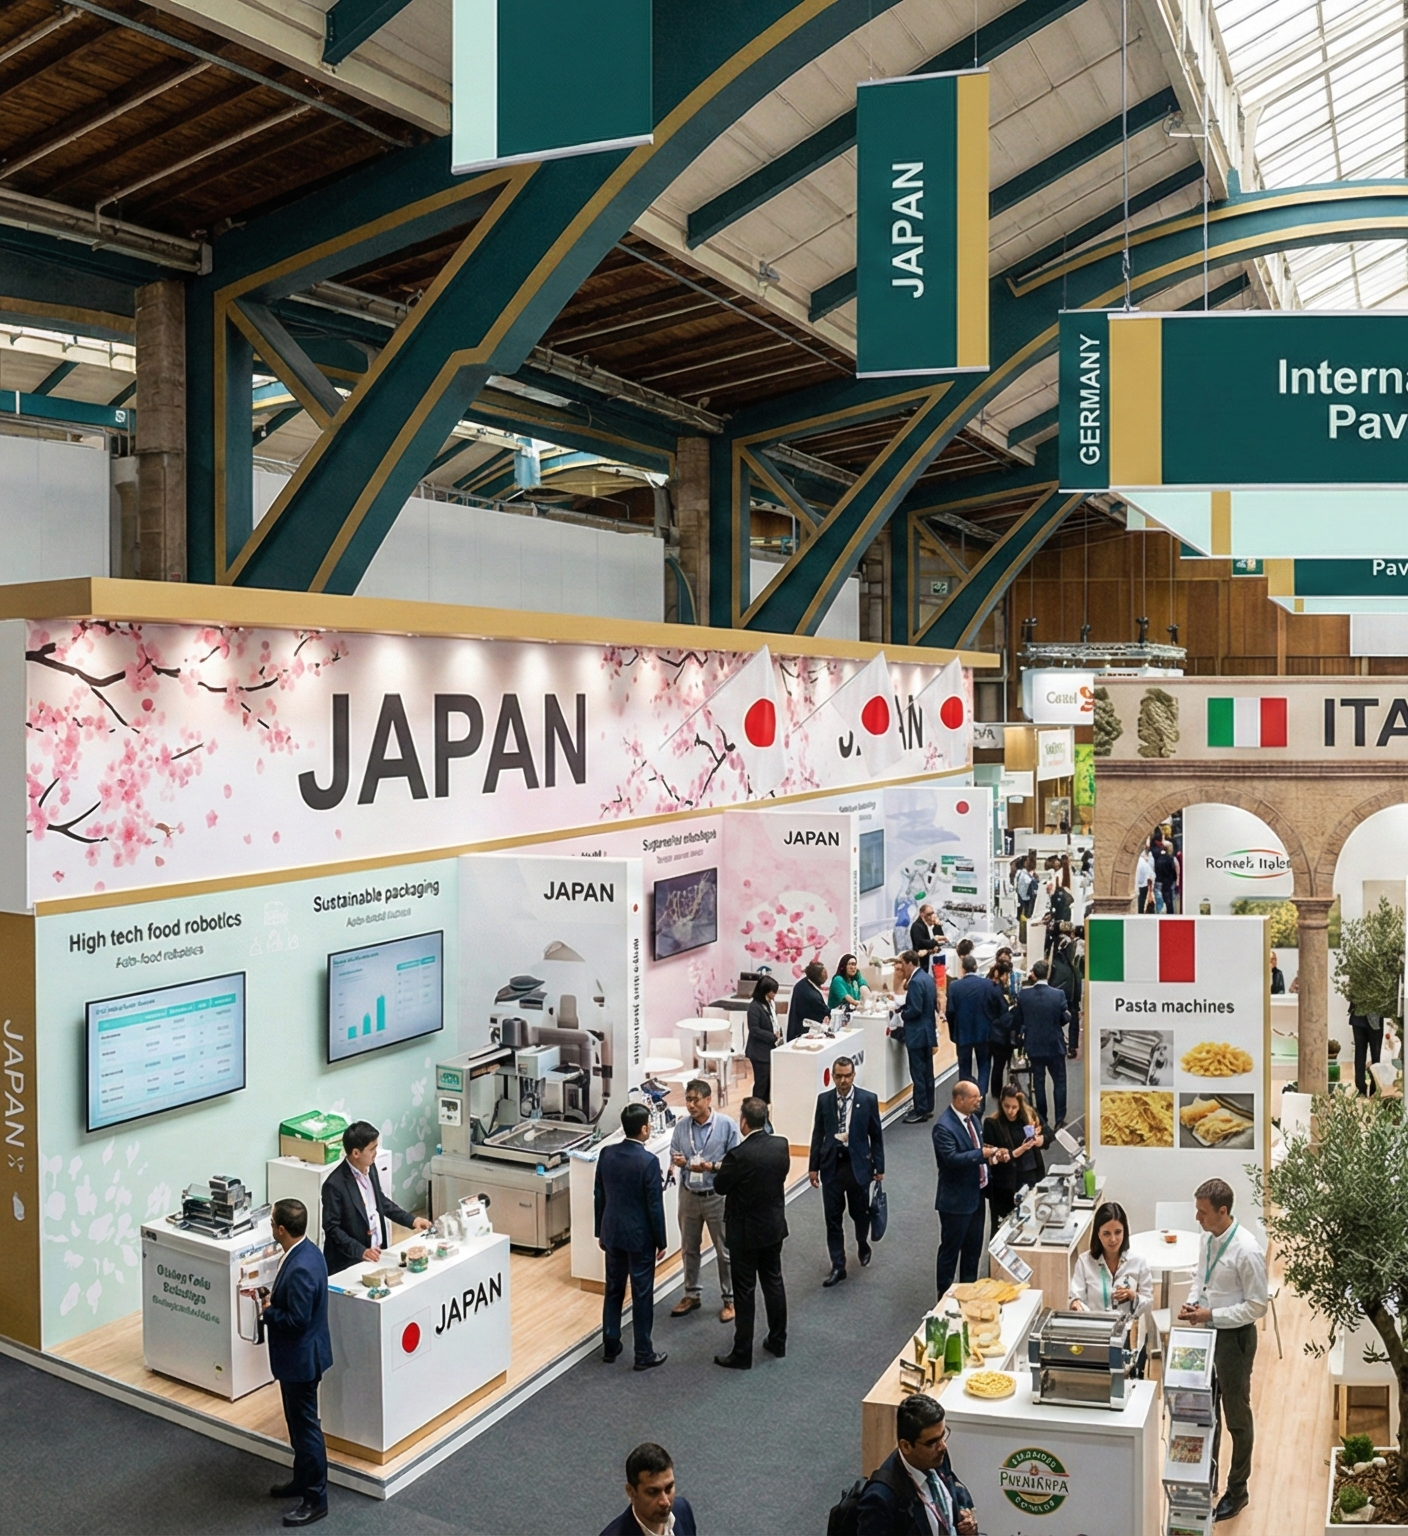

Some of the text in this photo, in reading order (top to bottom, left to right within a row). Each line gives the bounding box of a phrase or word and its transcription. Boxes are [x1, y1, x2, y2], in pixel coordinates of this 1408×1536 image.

[891, 161, 925, 299] JAPAN
[1079, 333, 1101, 465] GERMANY
[298, 693, 587, 811] JAPAN
[783, 830, 840, 846] JAPAN
[313, 879, 440, 913] Sustainable packaging
[543, 881, 615, 903] JAPAN
[69, 931, 106, 954] High
[111, 925, 144, 946] tech
[147, 918, 181, 941] food
[1115, 998, 1235, 1014] Pasta machines
[3, 1019, 25, 1147] JAPAN
[435, 1272, 502, 1335] JAPAN
